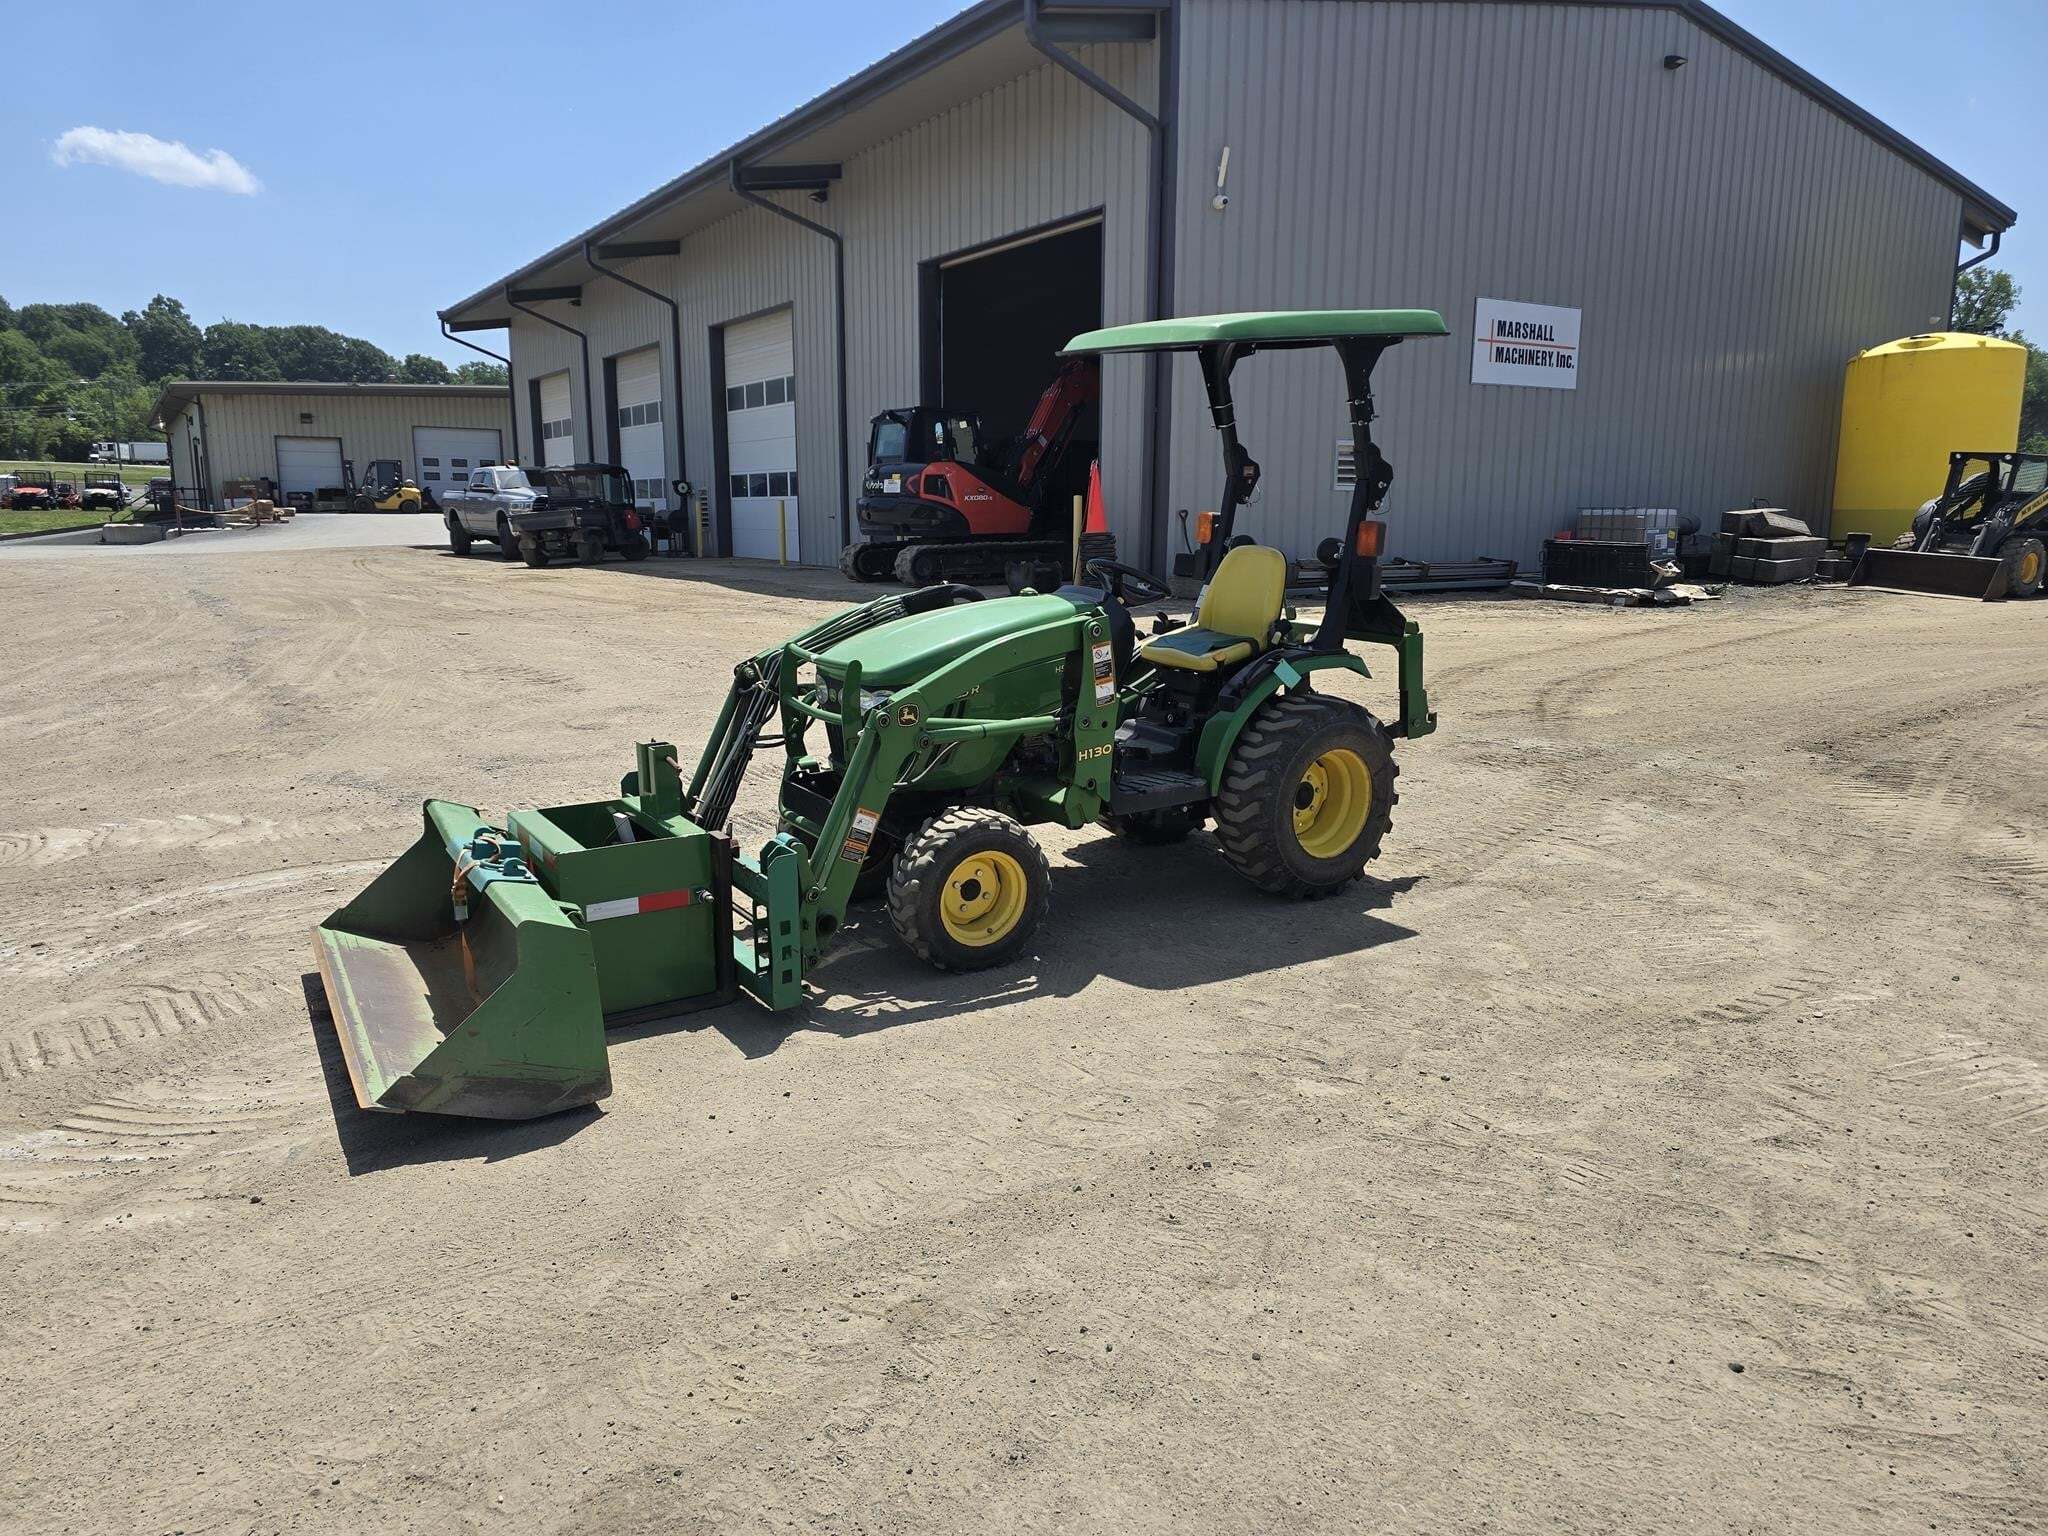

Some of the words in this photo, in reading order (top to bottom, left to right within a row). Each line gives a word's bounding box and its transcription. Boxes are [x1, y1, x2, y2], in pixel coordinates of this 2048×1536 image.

[1496, 319, 1555, 342] MARSHALL
[1494, 346, 1555, 368] MACHINERY,
[1555, 350, 1575, 369] Inc.
[1078, 744, 1112, 762] H130
